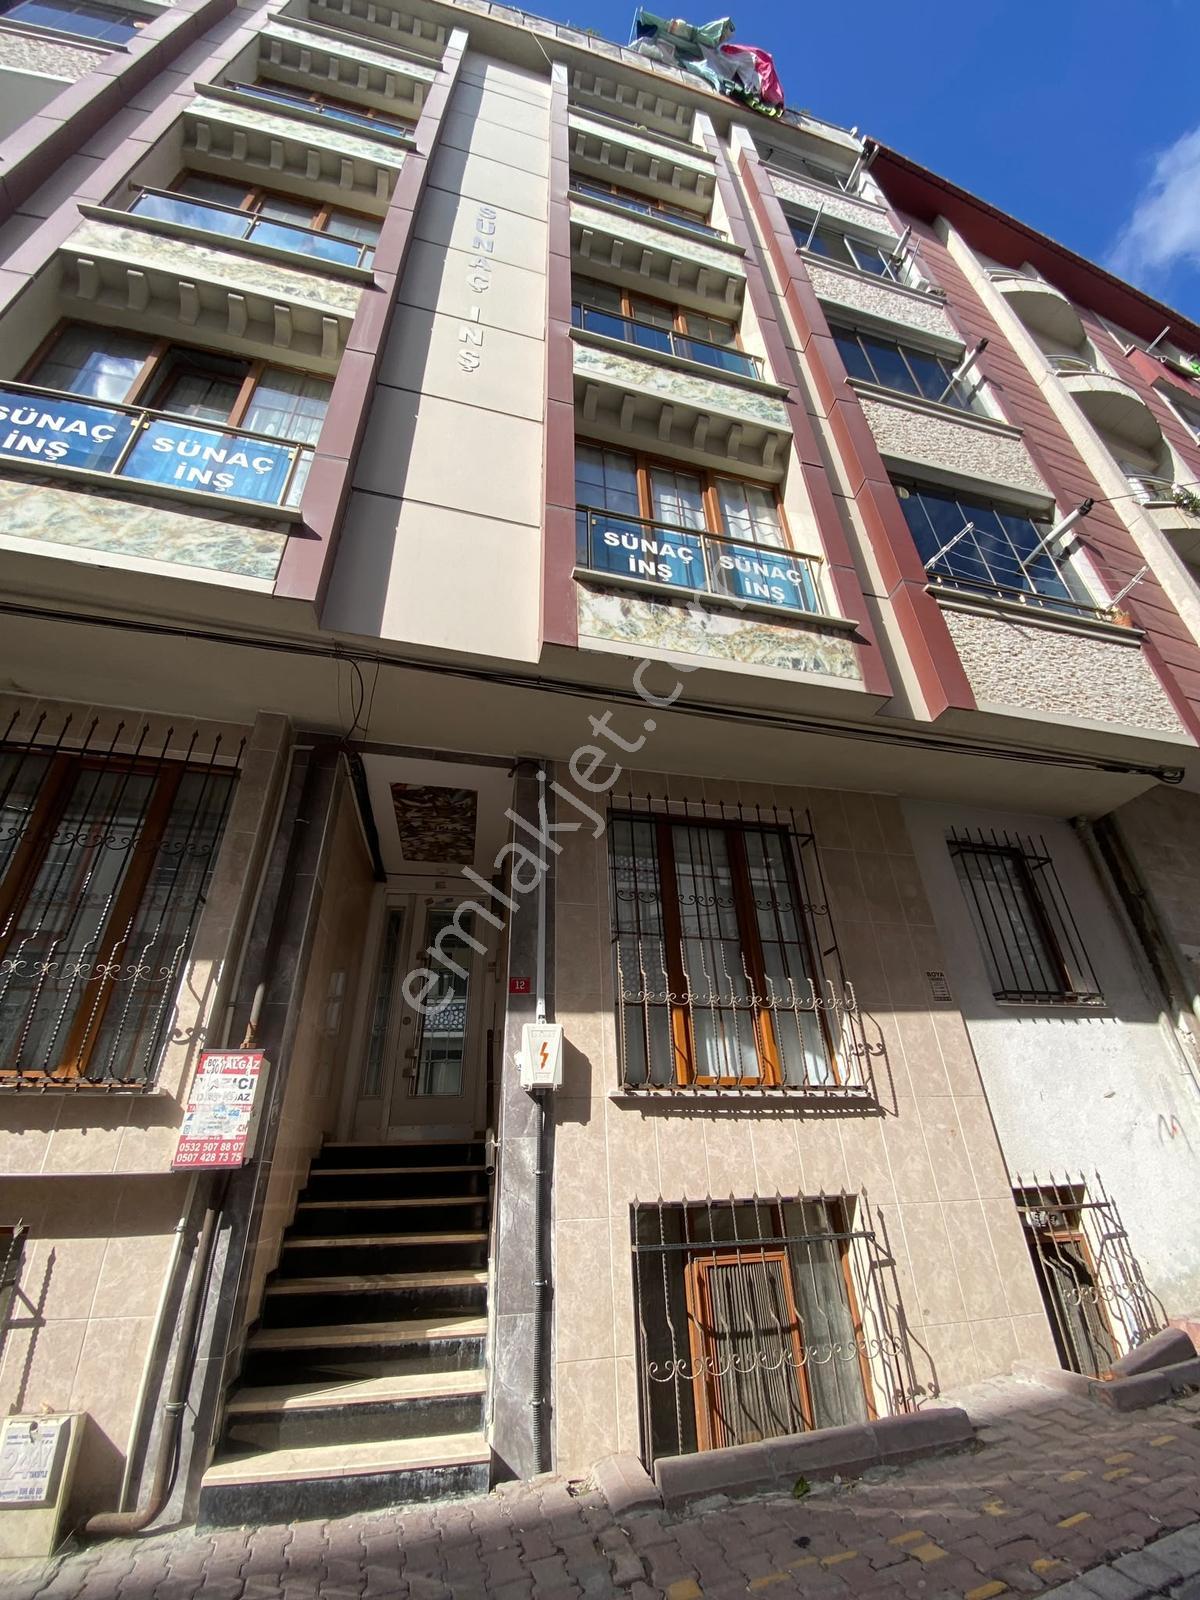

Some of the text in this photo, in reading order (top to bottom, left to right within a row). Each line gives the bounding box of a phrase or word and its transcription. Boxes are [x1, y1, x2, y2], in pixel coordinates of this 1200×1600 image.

[2, 429, 71, 461] İNŞ
[152, 437, 274, 475] SÜNAÇ
[173, 461, 235, 492] İNŞ
[604, 531, 694, 564] SÜNAÇ
[629, 553, 673, 582] İNŞ
[719, 555, 802, 587] SÜNAÇ
[744, 577, 785, 604] İNŞ
[515, 980, 526, 990] 12
[176, 1153, 199, 1162] 0507
[200, 1153, 216, 1162] 428
[231, 1152, 242, 1161] 75
[179, 1142, 201, 1152] 0532
[202, 1142, 219, 1152] 507
[232, 1142, 245, 1151] 07
